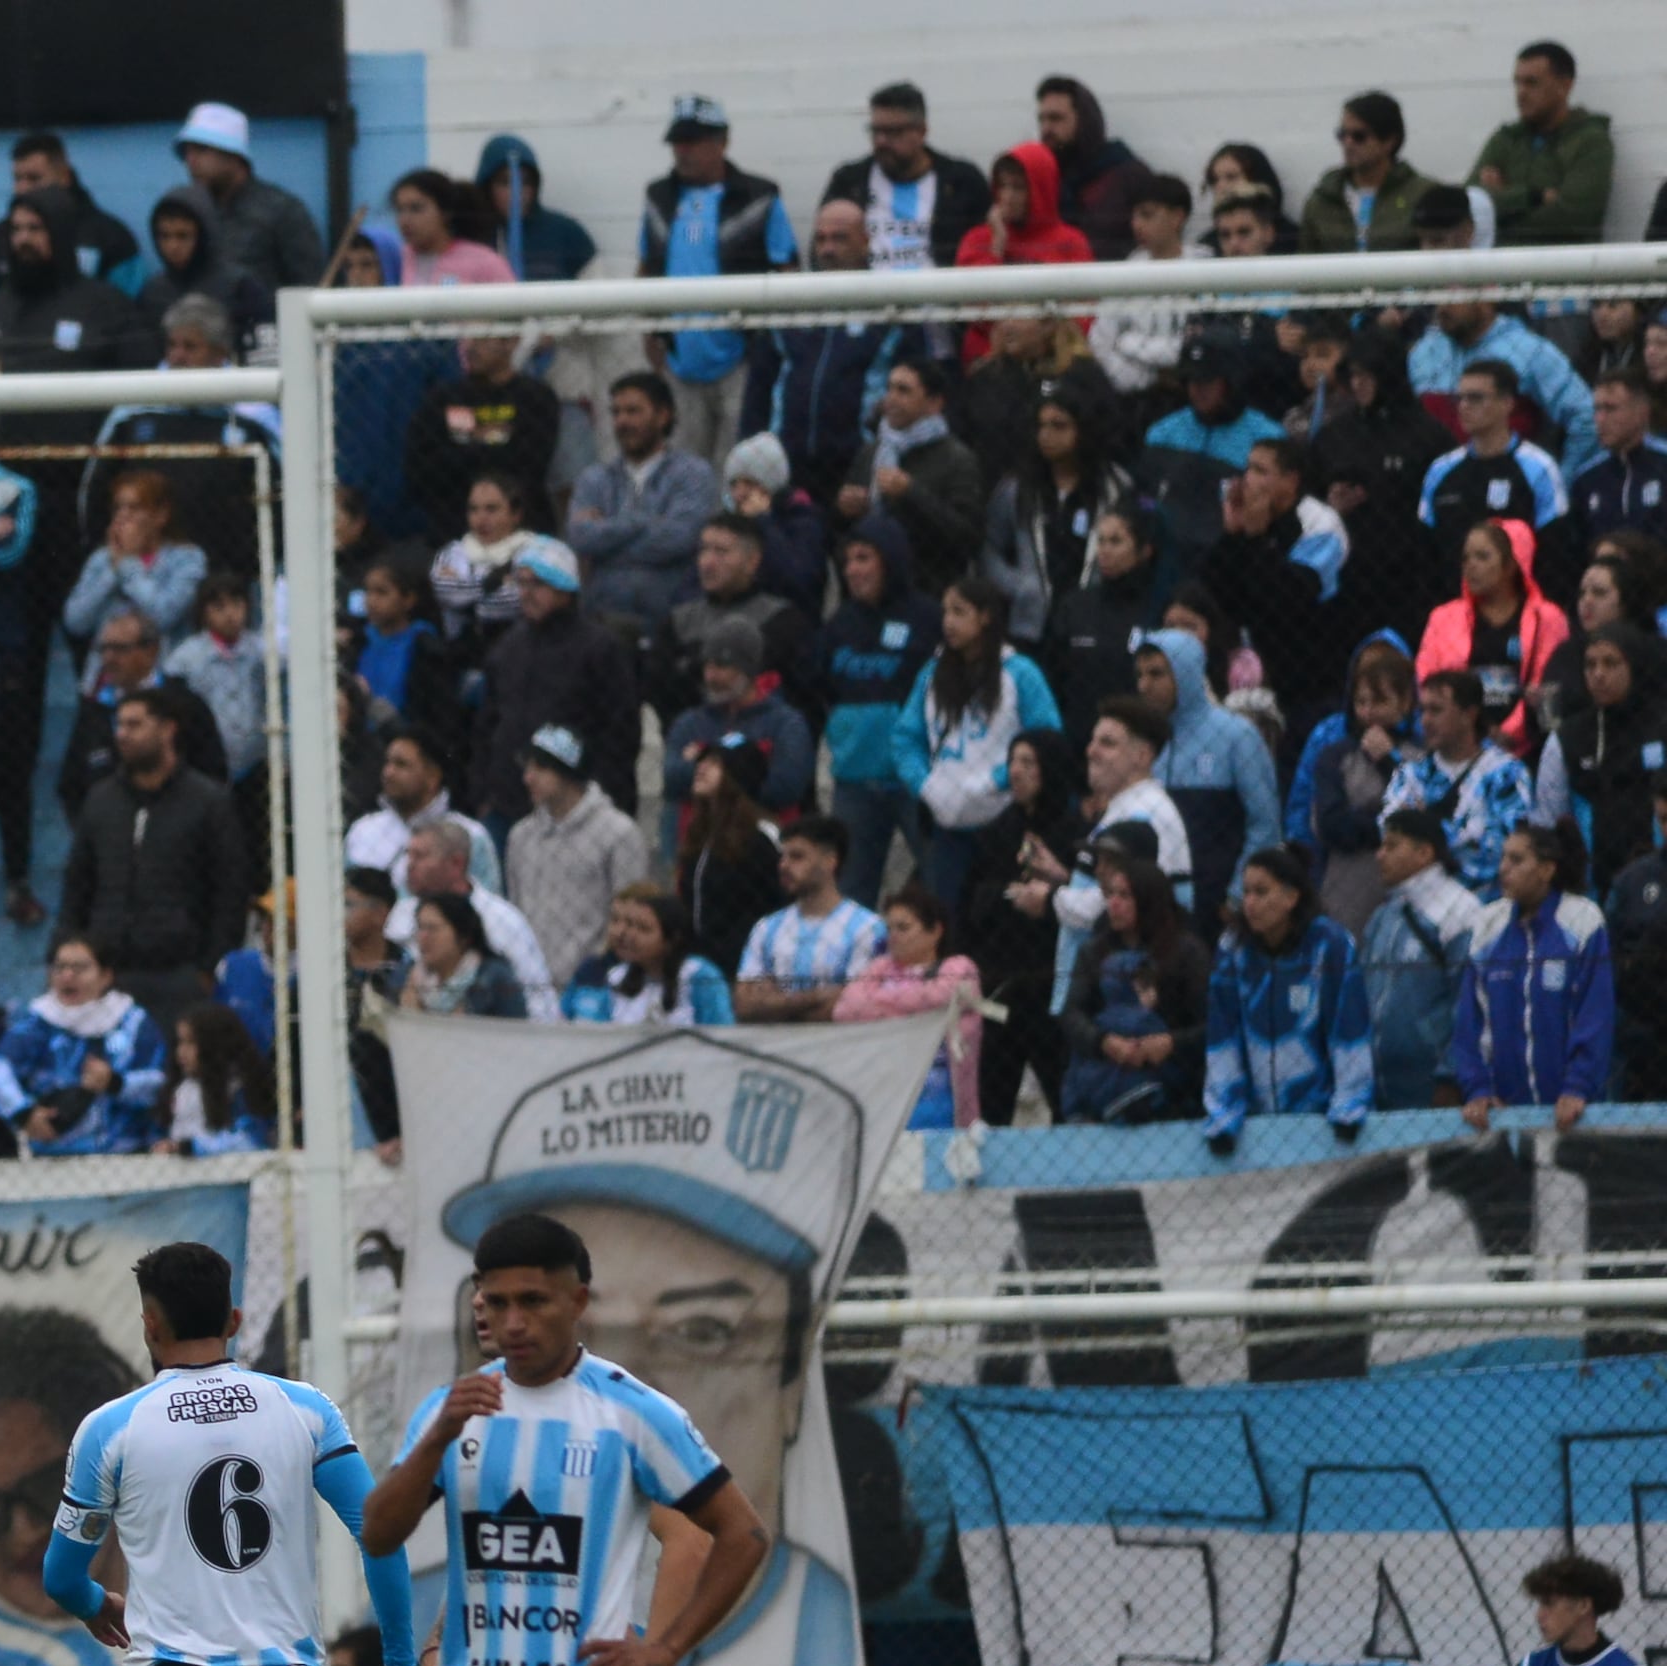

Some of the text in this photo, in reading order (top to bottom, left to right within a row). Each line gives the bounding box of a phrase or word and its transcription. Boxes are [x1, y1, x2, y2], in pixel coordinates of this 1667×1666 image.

[562, 1073, 685, 1114] LA CHAVI
[541, 1112, 711, 1156] LO MITERIO
[169, 1396, 258, 1422] FRESCAS
[170, 1383, 251, 1408] BROSAS
[183, 1453, 273, 1574] 6
[477, 1522, 565, 1566] GEA
[473, 1603, 581, 1636] BANCOR
